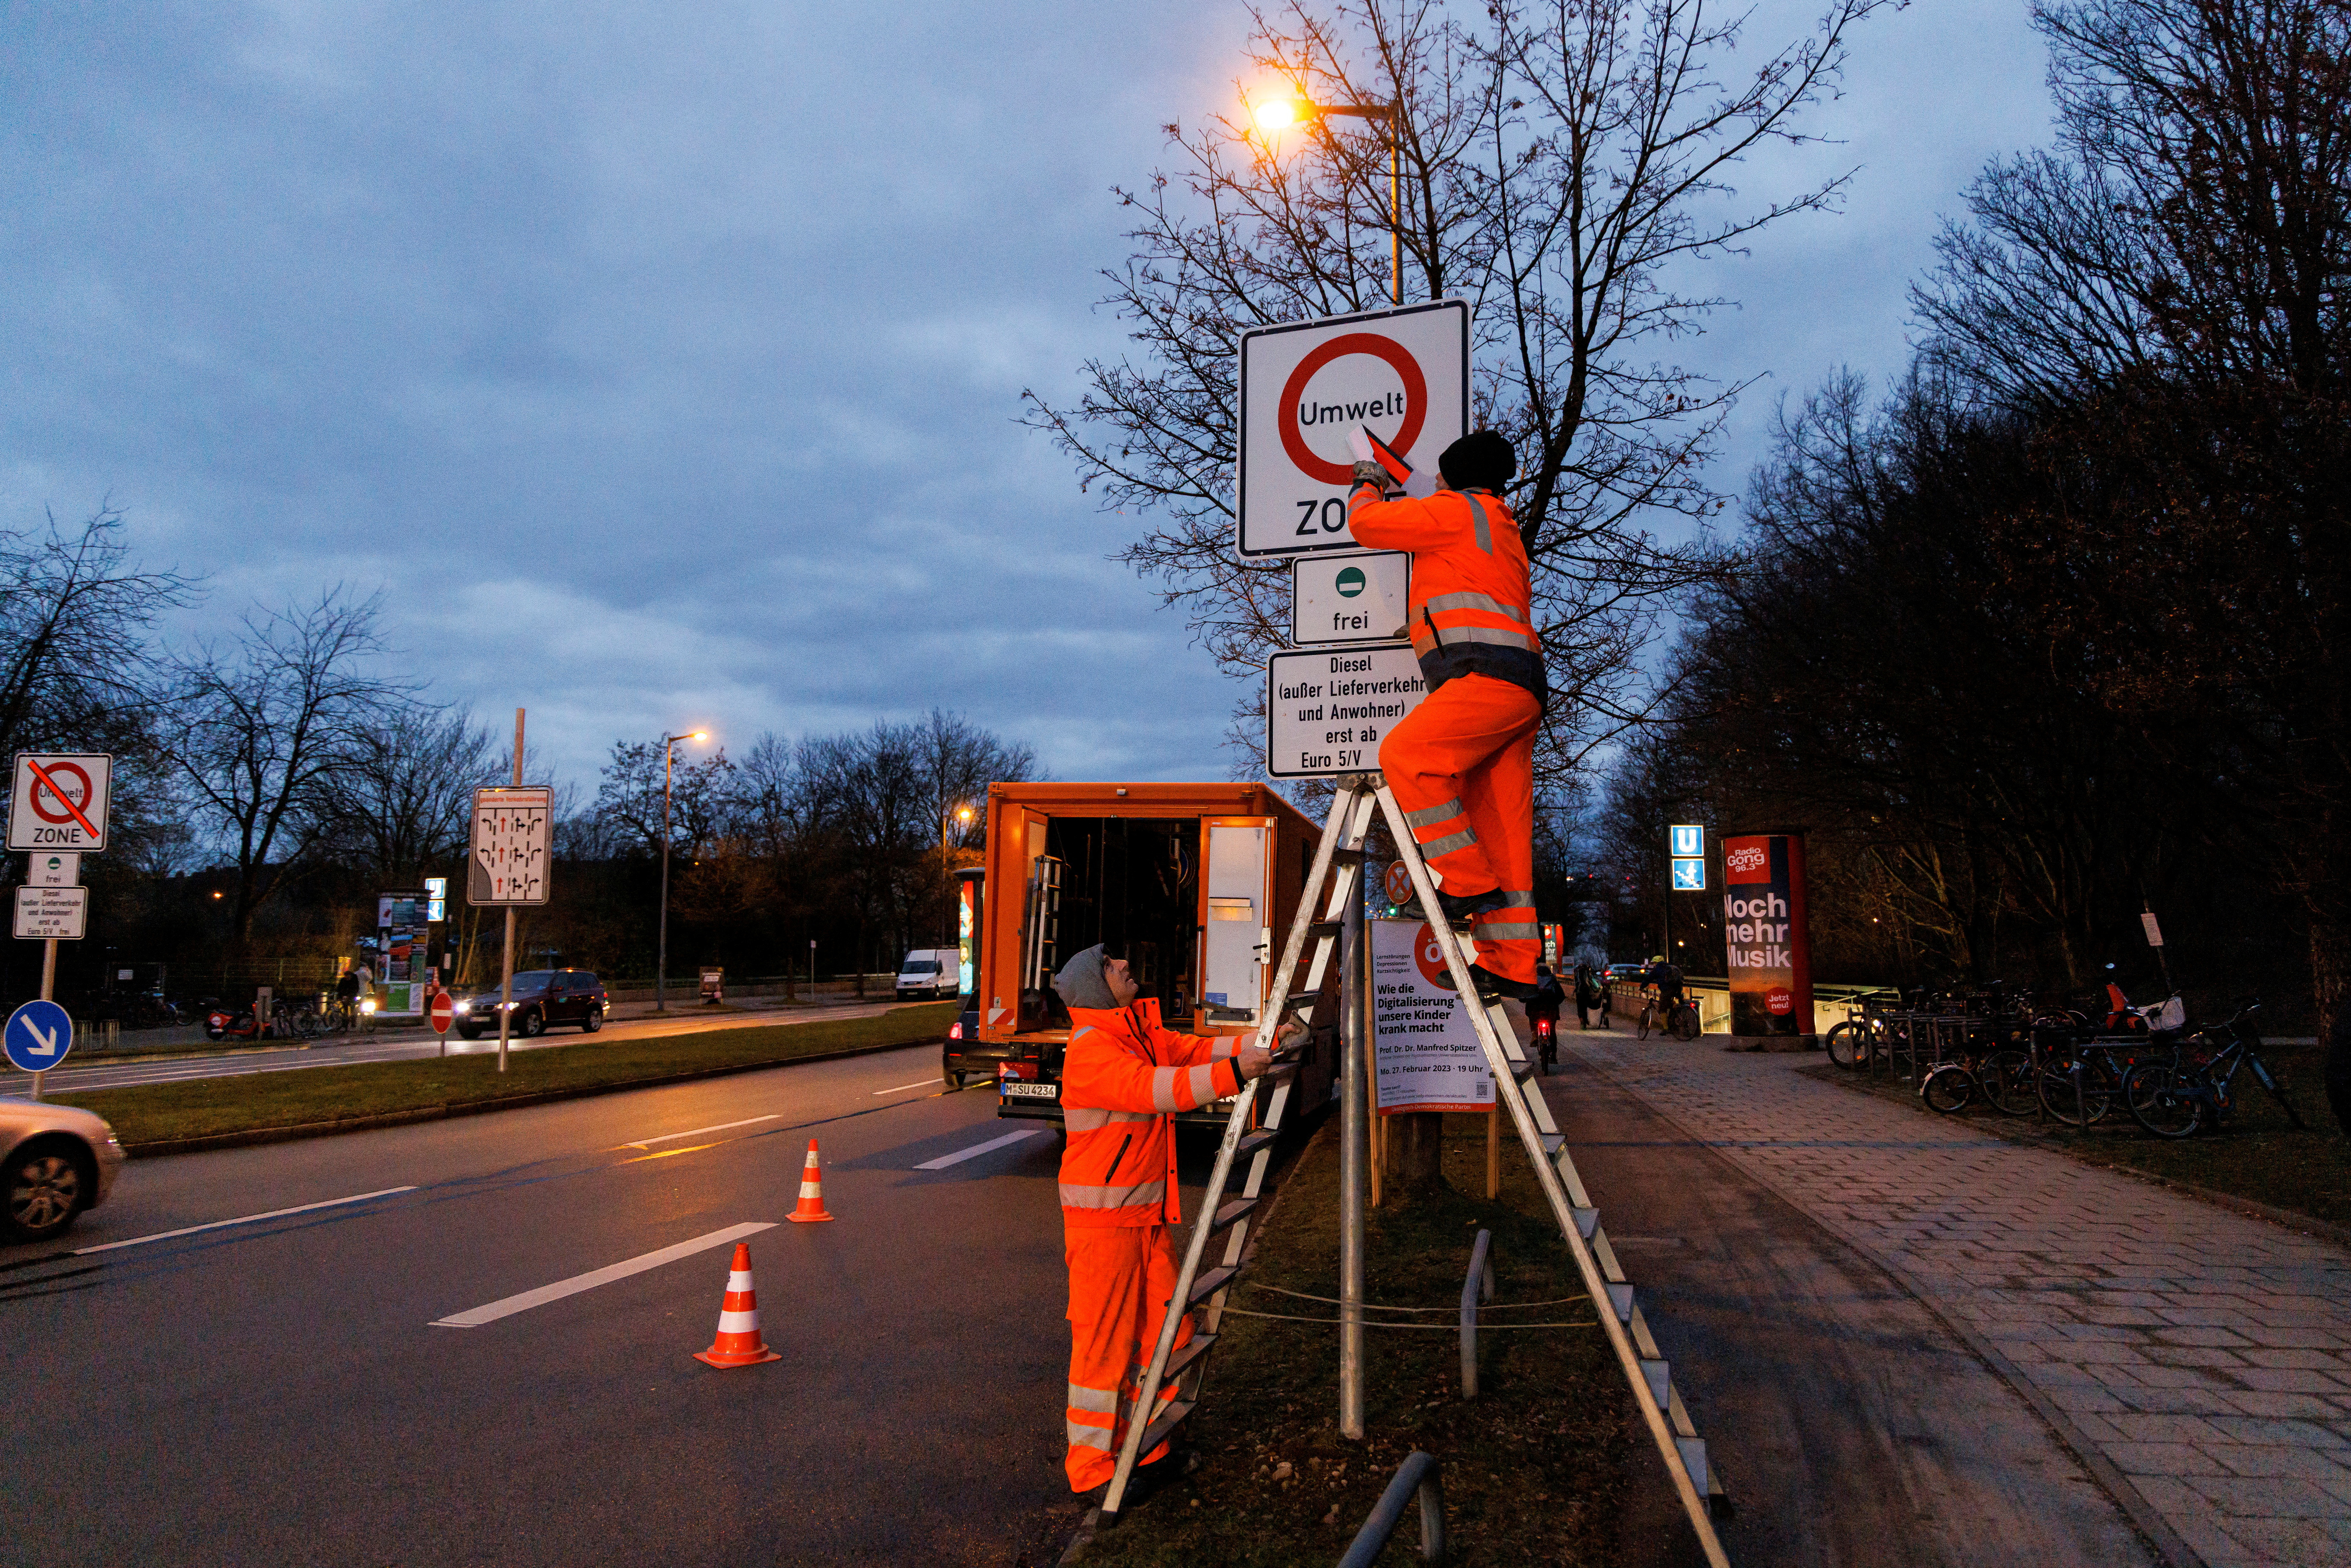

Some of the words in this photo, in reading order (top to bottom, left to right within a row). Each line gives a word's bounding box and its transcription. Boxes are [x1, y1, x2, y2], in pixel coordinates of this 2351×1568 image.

[1301, 392, 1403, 425] Umwelt
[1296, 491, 1407, 536] ZO
[1334, 611, 1368, 631] frei
[1330, 655, 1372, 673] Diesel
[1279, 682, 1323, 700] (außer
[1330, 676, 1425, 698] Lieferverkehr
[1299, 705, 1323, 722] und
[1331, 699, 1405, 720] Anwohner)
[1326, 728, 1353, 744] erst
[1361, 726, 1377, 743] ab
[1302, 752, 1331, 769] Euro
[1339, 750, 1361, 766] 5/V
[34, 828, 81, 843] ZONE
[1678, 829, 1697, 852] U
[1727, 854, 1765, 866] Gong
[1735, 847, 1761, 856] Radio
[1735, 863, 1756, 872] 96.3
[1724, 892, 1787, 918] Noch
[1726, 919, 1788, 943] mehr
[1727, 945, 1791, 967] Musik
[1377, 984, 1396, 994] Wie
[1398, 983, 1414, 993] die
[1378, 996, 1455, 1010] Digitalisierung
[1379, 1012, 1411, 1022] unsere
[1414, 1009, 1451, 1020] Kinder
[1379, 1023, 1407, 1035] krank
[1409, 1022, 1444, 1032] macht
[1450, 1044, 1477, 1053] Spitzer
[1006, 1084, 1012, 1094] M
[1018, 1085, 1030, 1095] SU
[1031, 1085, 1054, 1096] 4234
[1391, 1104, 1454, 1112] Ökologisch-Demokratische
